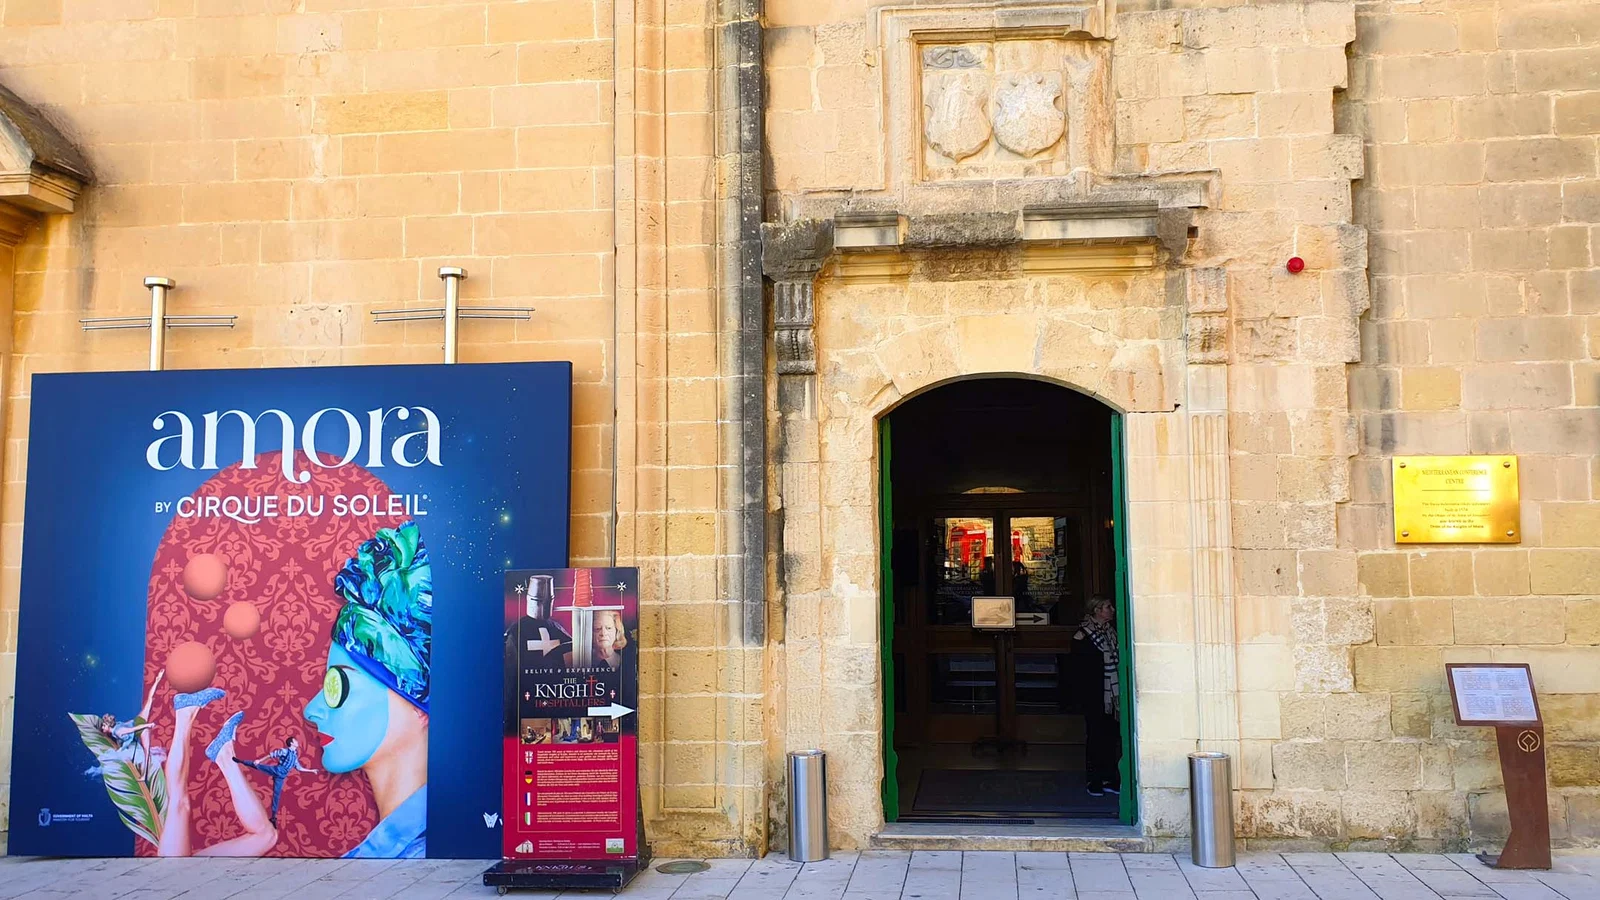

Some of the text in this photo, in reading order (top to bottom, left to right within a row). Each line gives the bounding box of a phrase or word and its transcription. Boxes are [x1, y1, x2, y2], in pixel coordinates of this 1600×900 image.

[146, 406, 444, 484] amora
[155, 502, 171, 513] BY
[176, 496, 278, 524] CIRQUE
[287, 495, 324, 516] DU
[535, 698, 606, 708] HOSPITALLERS
